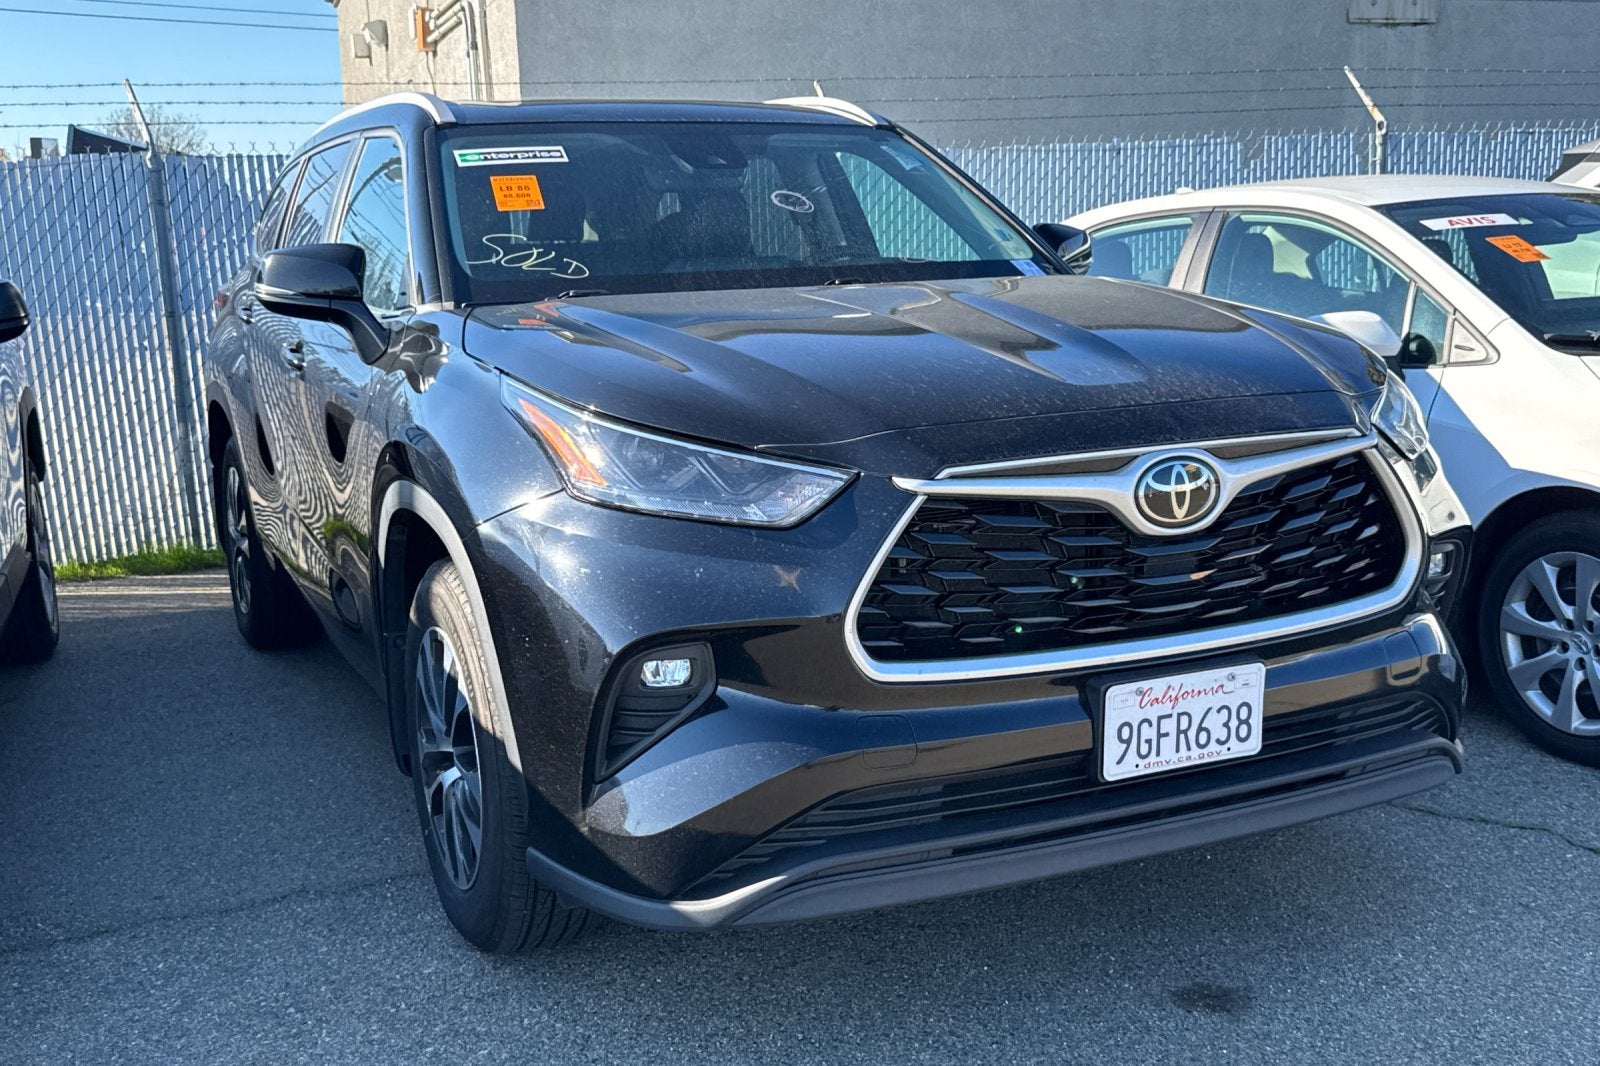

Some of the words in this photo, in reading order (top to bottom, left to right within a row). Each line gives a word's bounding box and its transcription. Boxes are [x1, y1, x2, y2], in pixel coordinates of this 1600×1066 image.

[461, 150, 562, 162] enterprise
[1447, 216, 1497, 227] AVIS
[464, 233, 589, 279] SOLD
[1138, 682, 1235, 710] California
[1116, 701, 1253, 766] 9GFR638
[1143, 749, 1223, 769] dmv.ca.gov
